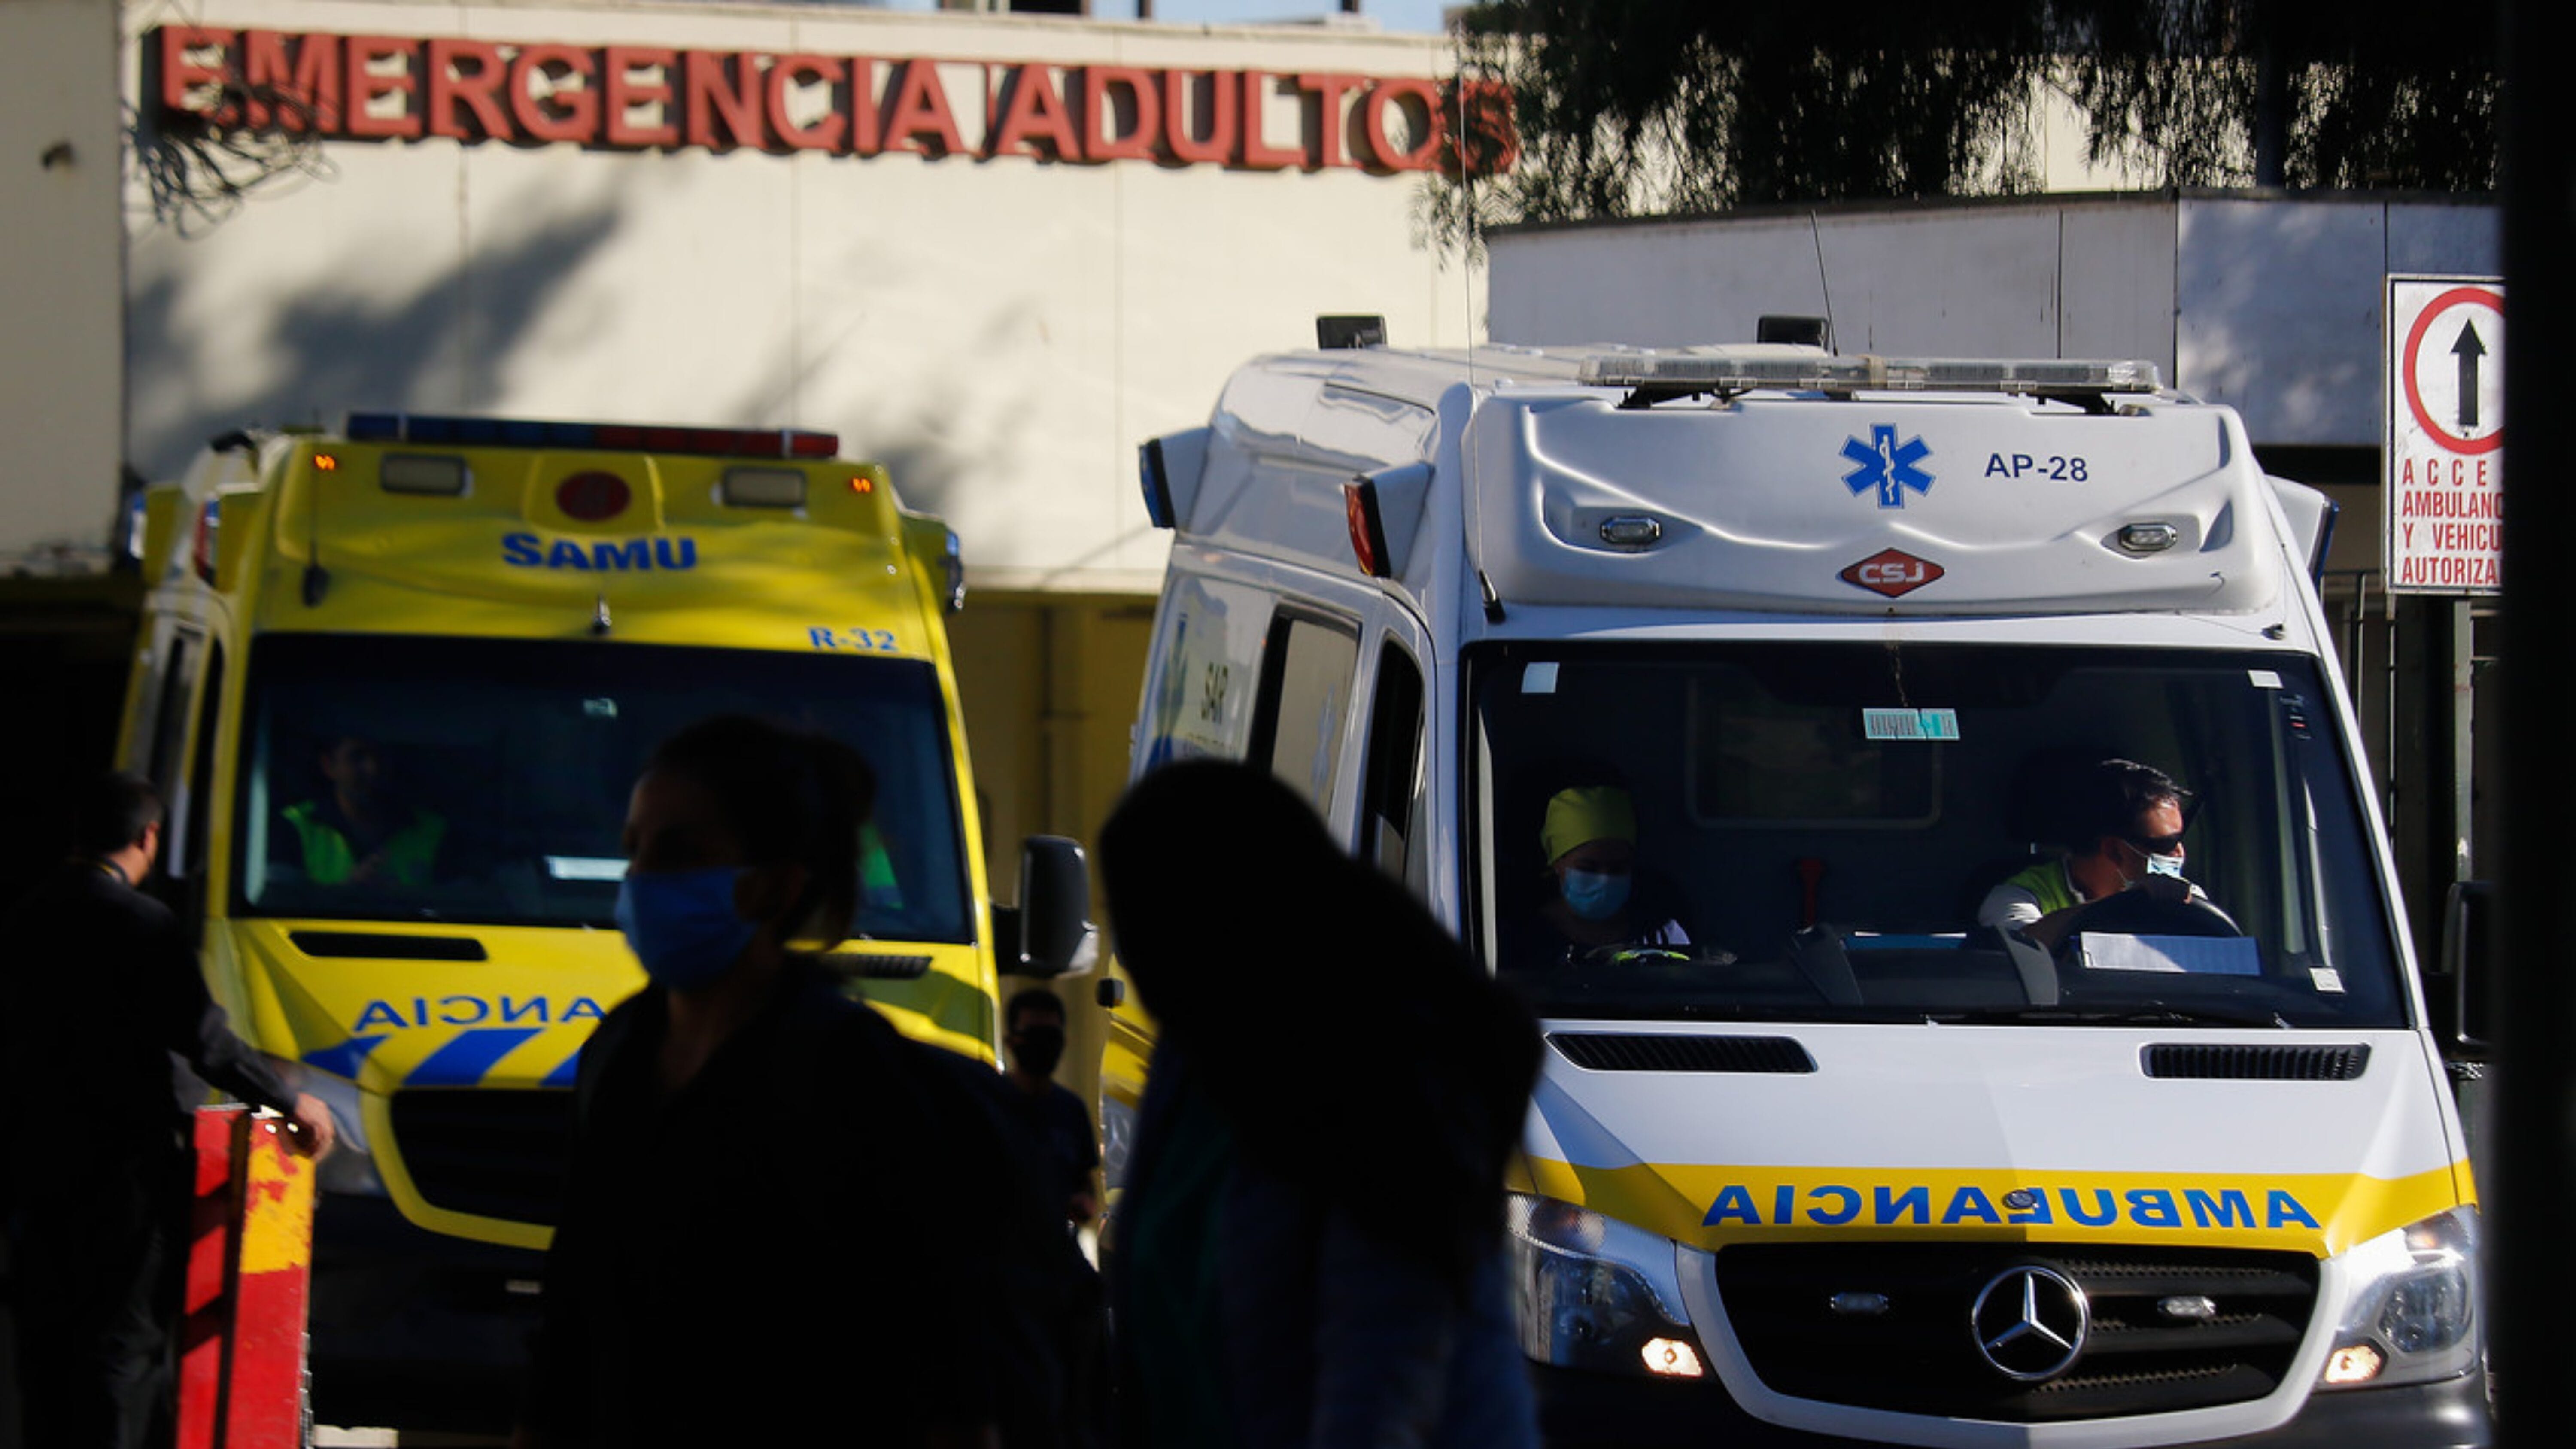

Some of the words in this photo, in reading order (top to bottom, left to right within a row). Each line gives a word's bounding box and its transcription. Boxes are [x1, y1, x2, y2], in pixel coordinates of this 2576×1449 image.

[161, 26, 964, 157] EMERGENCIA
[993, 61, 1516, 173] ADULTOS
[1984, 453, 2087, 482] AP-28
[2403, 523, 2414, 549] Y
[502, 534, 696, 570] SAMU
[1858, 562, 1924, 583] CSJ
[805, 626, 897, 653] R-32
